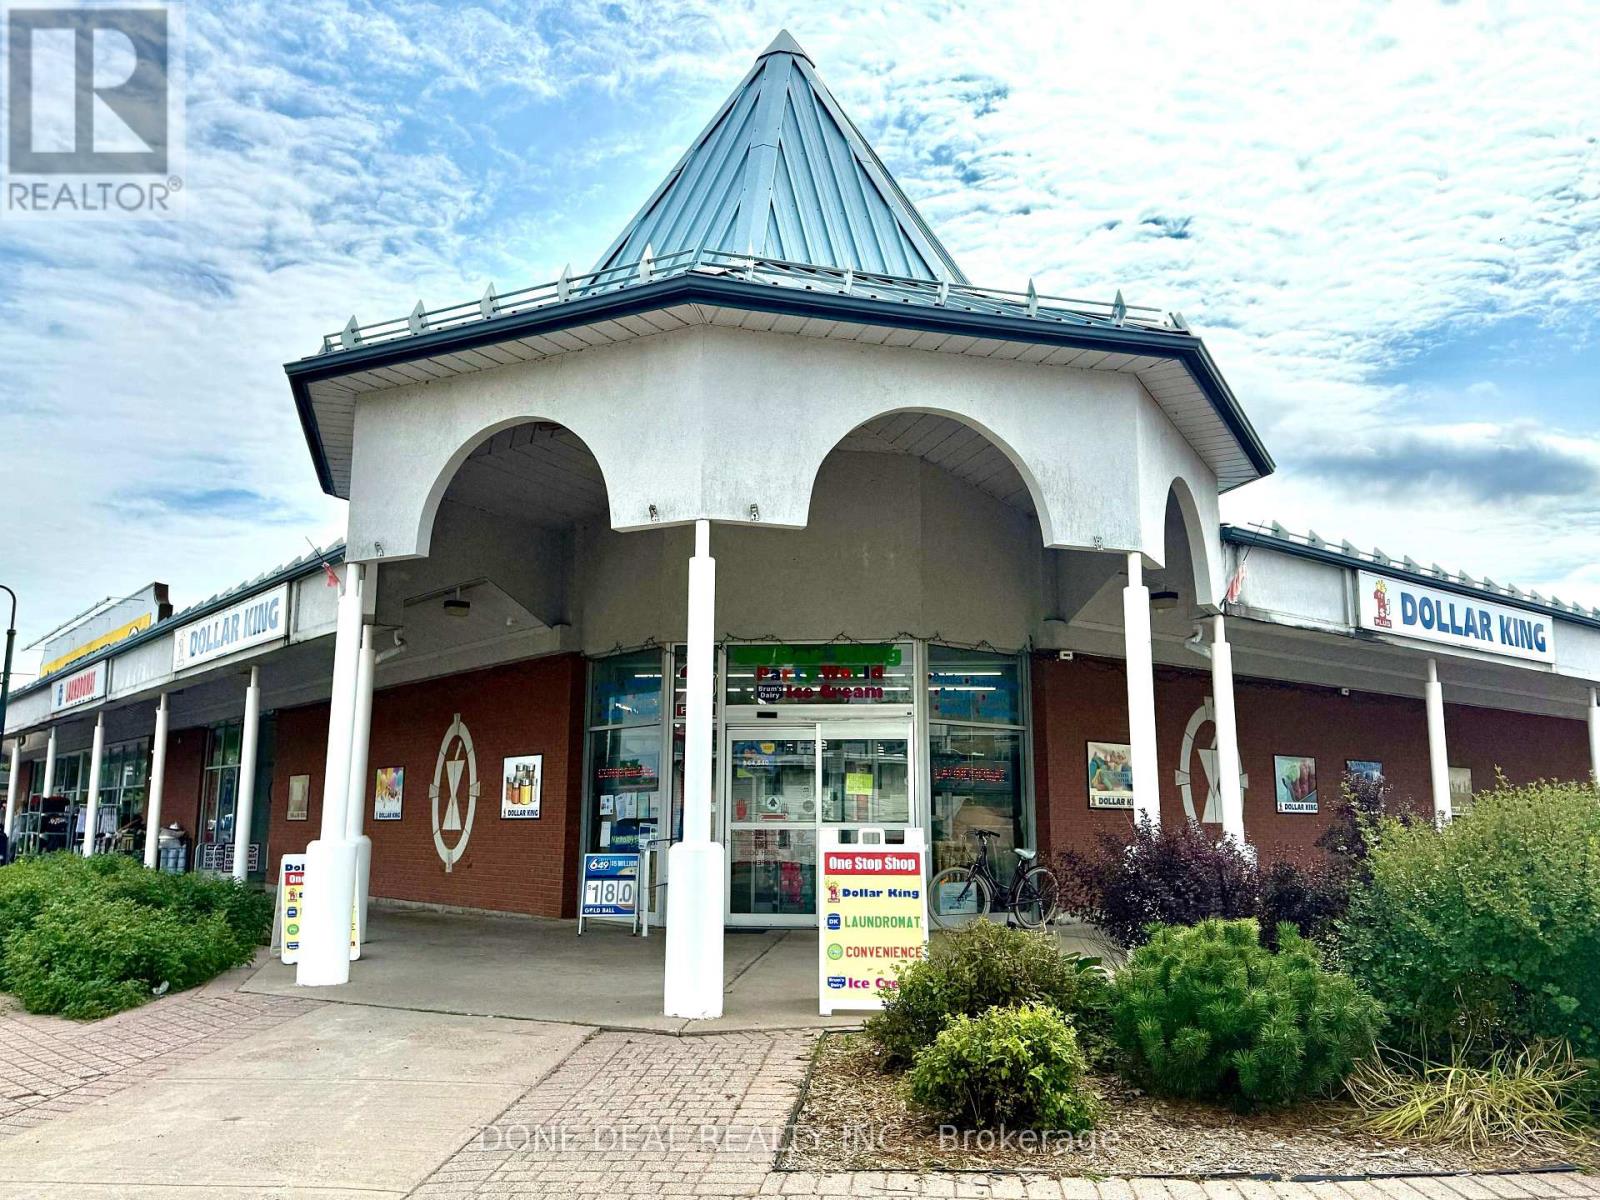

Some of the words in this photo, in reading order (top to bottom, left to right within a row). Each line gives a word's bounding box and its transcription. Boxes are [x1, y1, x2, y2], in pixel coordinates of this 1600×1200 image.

[190, 613, 240, 657] DOLLAR
[243, 597, 279, 638] KING
[1401, 592, 1494, 642] DOLLAR
[1499, 615, 1547, 653] KING
[785, 685, 814, 699] Ice
[819, 684, 884, 699] Cream
[1098, 798, 1126, 806] DOLLAR
[829, 857, 852, 870] One
[855, 857, 883, 871] Stop
[884, 857, 916, 871] Shop
[289, 874, 304, 883] On
[842, 889, 883, 897] Dollar
[888, 889, 919, 899] King
[845, 916, 921, 928] LAUNDROMAT
[846, 946, 922, 958] CONVENIENCE
[849, 978, 870, 988] Ice
[875, 978, 899, 988] Cre
